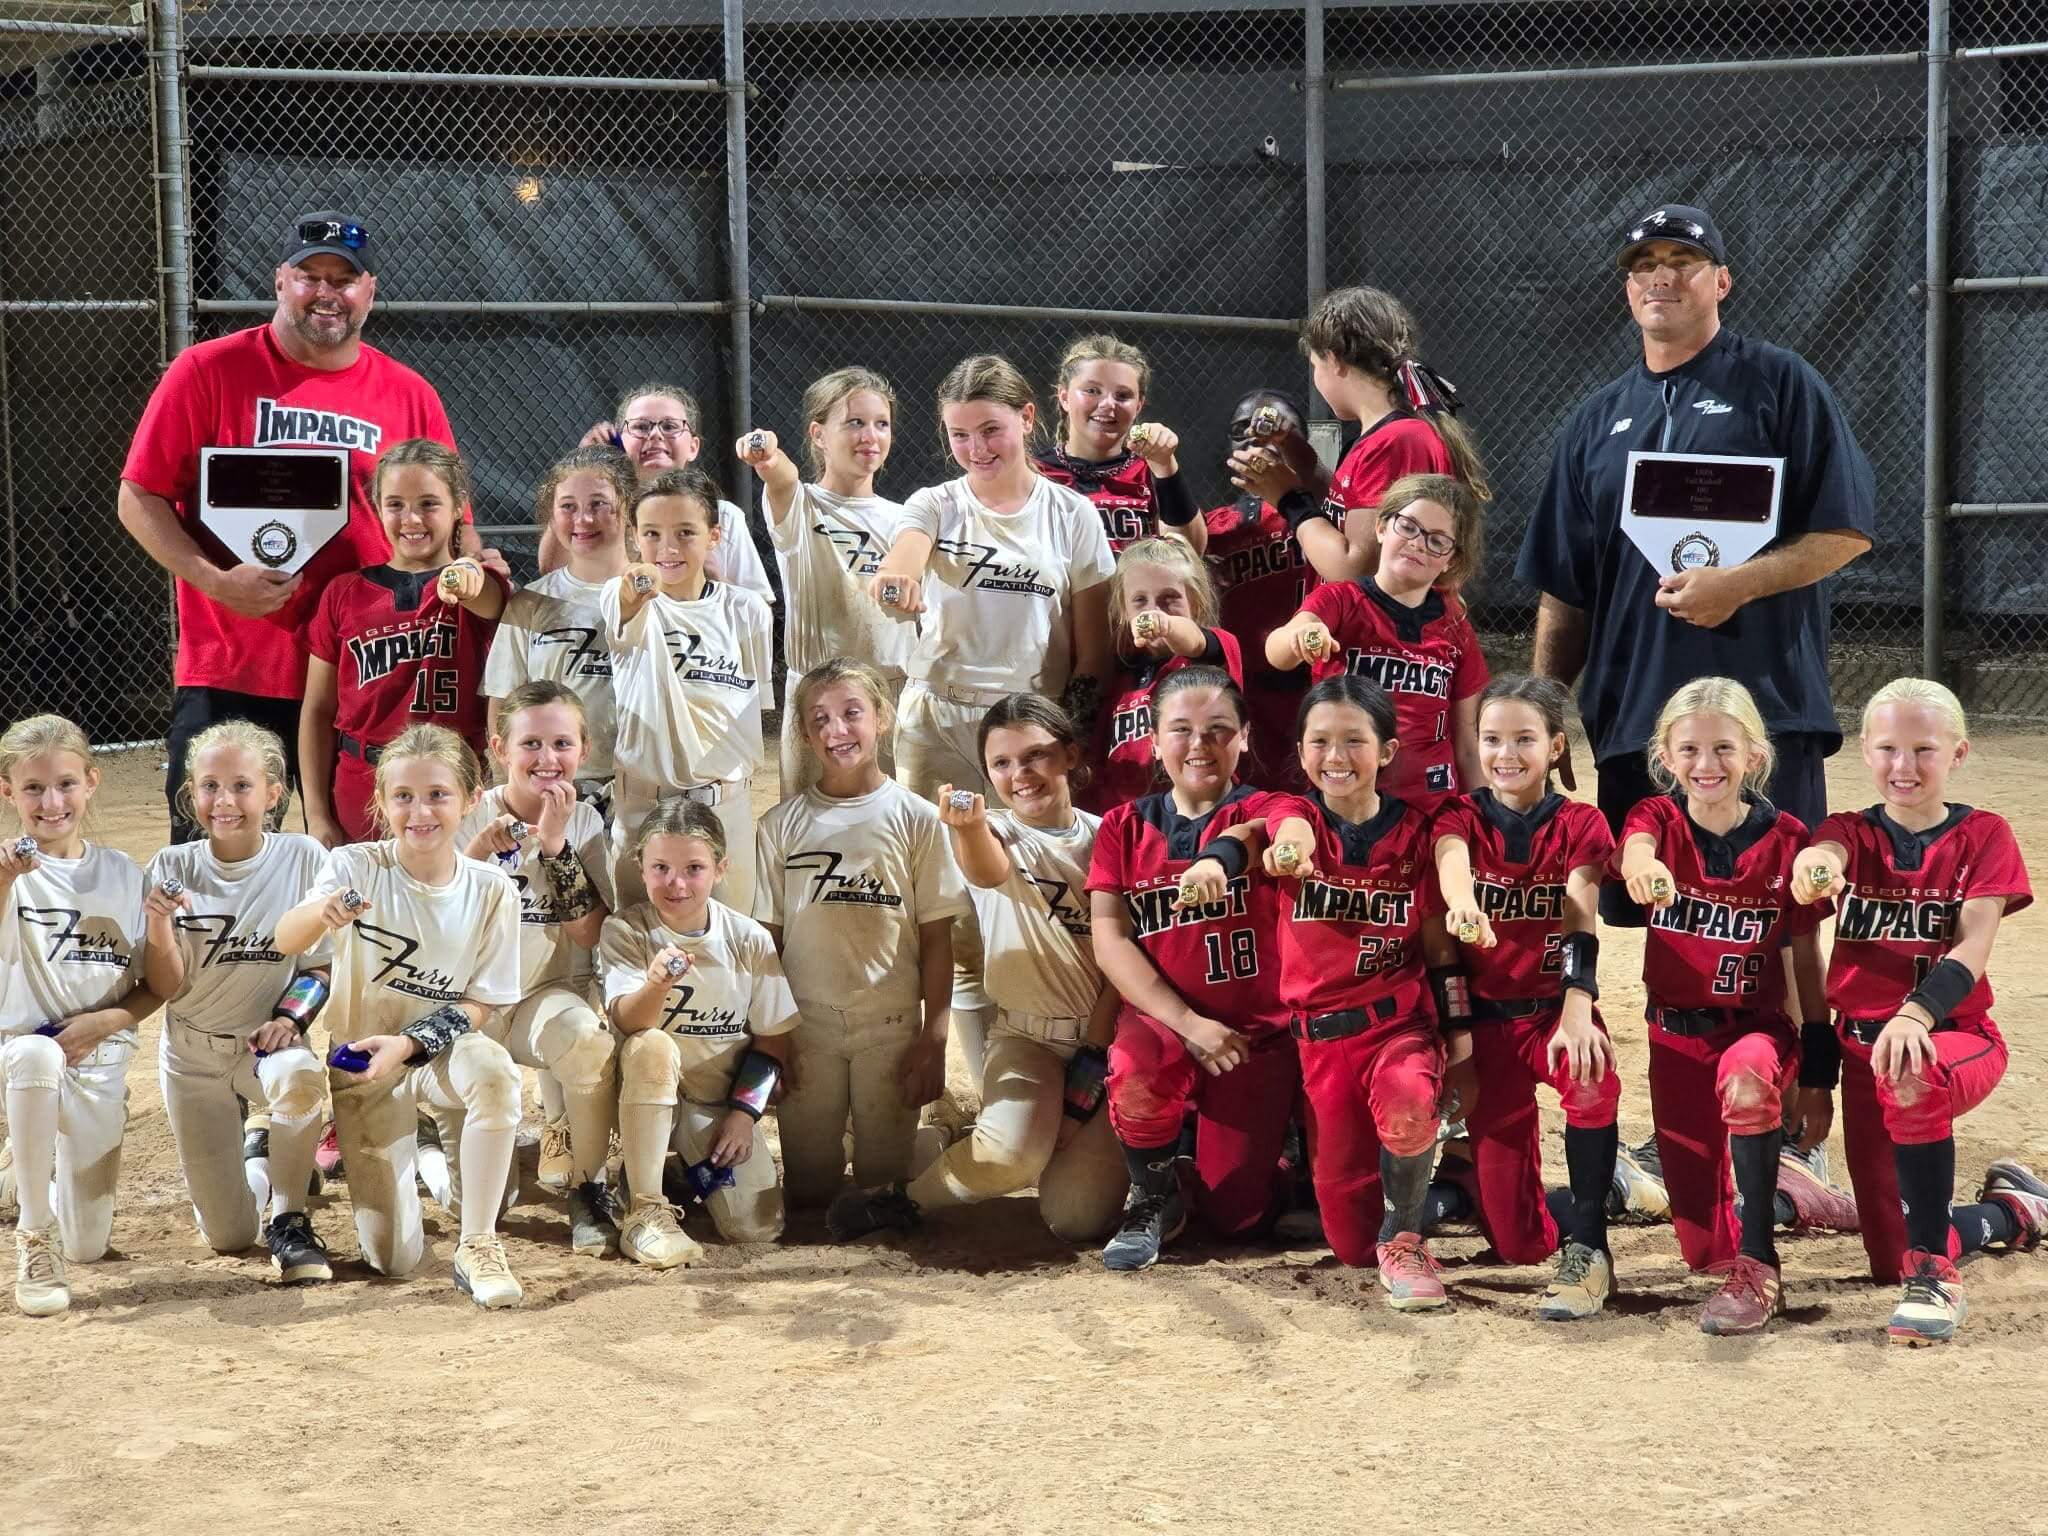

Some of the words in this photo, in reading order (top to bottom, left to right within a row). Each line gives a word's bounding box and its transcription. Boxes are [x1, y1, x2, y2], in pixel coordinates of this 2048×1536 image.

[254, 398, 381, 454] IMPACT
[937, 539, 1039, 588] Fury
[1229, 538, 1306, 588] PACT
[982, 579, 1053, 596] PLATINUM
[347, 622, 459, 690] IMPACT
[664, 630, 739, 677] Fury
[409, 668, 459, 714] 15
[689, 669, 750, 689] PLATINUM
[784, 851, 884, 903] Fury
[828, 892, 899, 904] PLATINUM
[1313, 869, 1409, 889] GEORGIA
[1679, 884, 1778, 905] GEORGIA
[1293, 879, 1414, 927] IMPACT
[1651, 890, 1780, 944] IMPACT
[1836, 882, 1963, 942] IMPACT
[18, 906, 118, 962] Fury
[175, 915, 276, 968] Fury
[353, 919, 454, 983] Fury
[1205, 928, 1259, 984] 18
[393, 979, 463, 1000] PLATINUM
[1712, 953, 1767, 995] 99
[660, 985, 736, 1030] Fury
